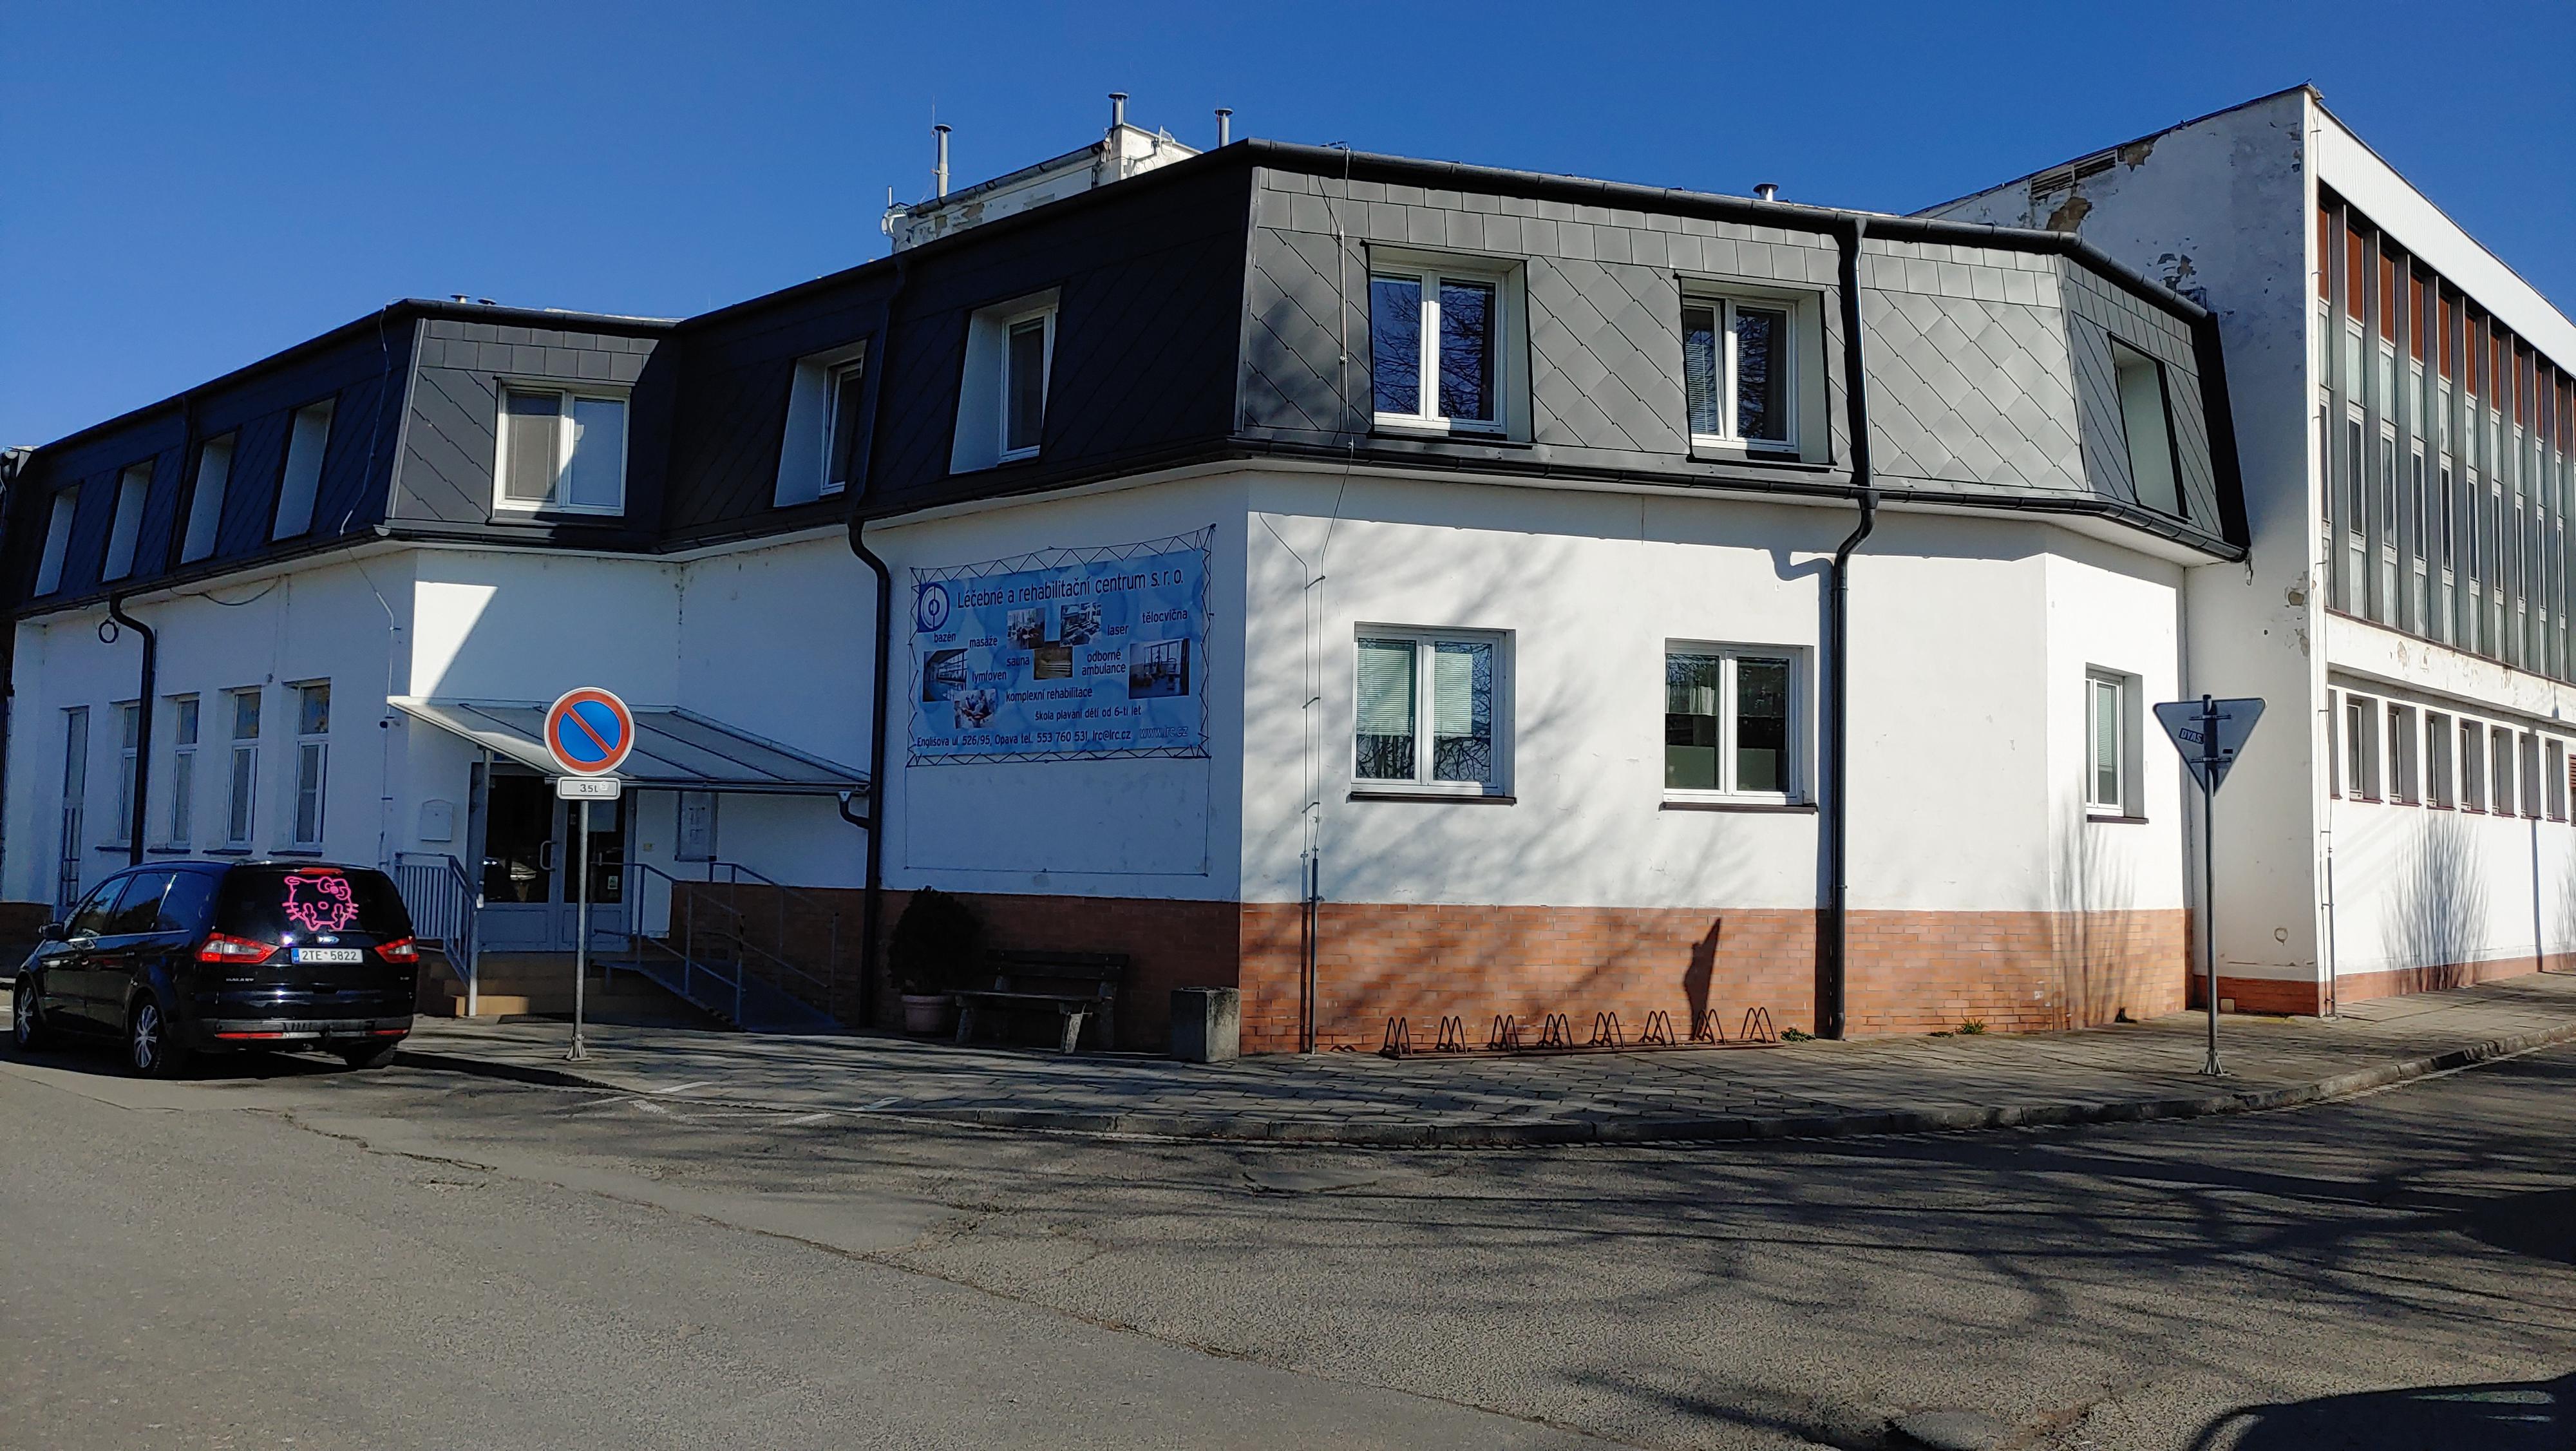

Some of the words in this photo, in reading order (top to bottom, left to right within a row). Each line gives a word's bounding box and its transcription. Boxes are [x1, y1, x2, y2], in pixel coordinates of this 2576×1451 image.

[957, 587, 1004, 609] Léčebné
[1007, 590, 1015, 604] a
[1018, 576, 1091, 602] rehabilitační
[1095, 573, 1146, 594] centrum
[1142, 608, 1188, 624] tělocvična
[933, 631, 956, 643] bazén
[1107, 624, 1129, 636] laser
[1006, 656, 1030, 667] sauna
[1086, 648, 1121, 662] odborné
[1081, 662, 1126, 676] ambulance
[972, 670, 1007, 684] lymfoven
[1005, 688, 1046, 703] komplexní
[1046, 686, 1093, 700] rehabilitace
[1035, 710, 1054, 721] škola
[1102, 706, 1112, 717] od
[1131, 705, 1142, 716] let
[917, 736, 949, 748] Englišova
[962, 734, 992, 746] 526/95,
[994, 734, 1018, 746] Opava
[1037, 732, 1052, 743] 553
[1056, 731, 1072, 742] 760
[301, 951, 323, 961] 2TE
[330, 951, 358, 961] 5822
